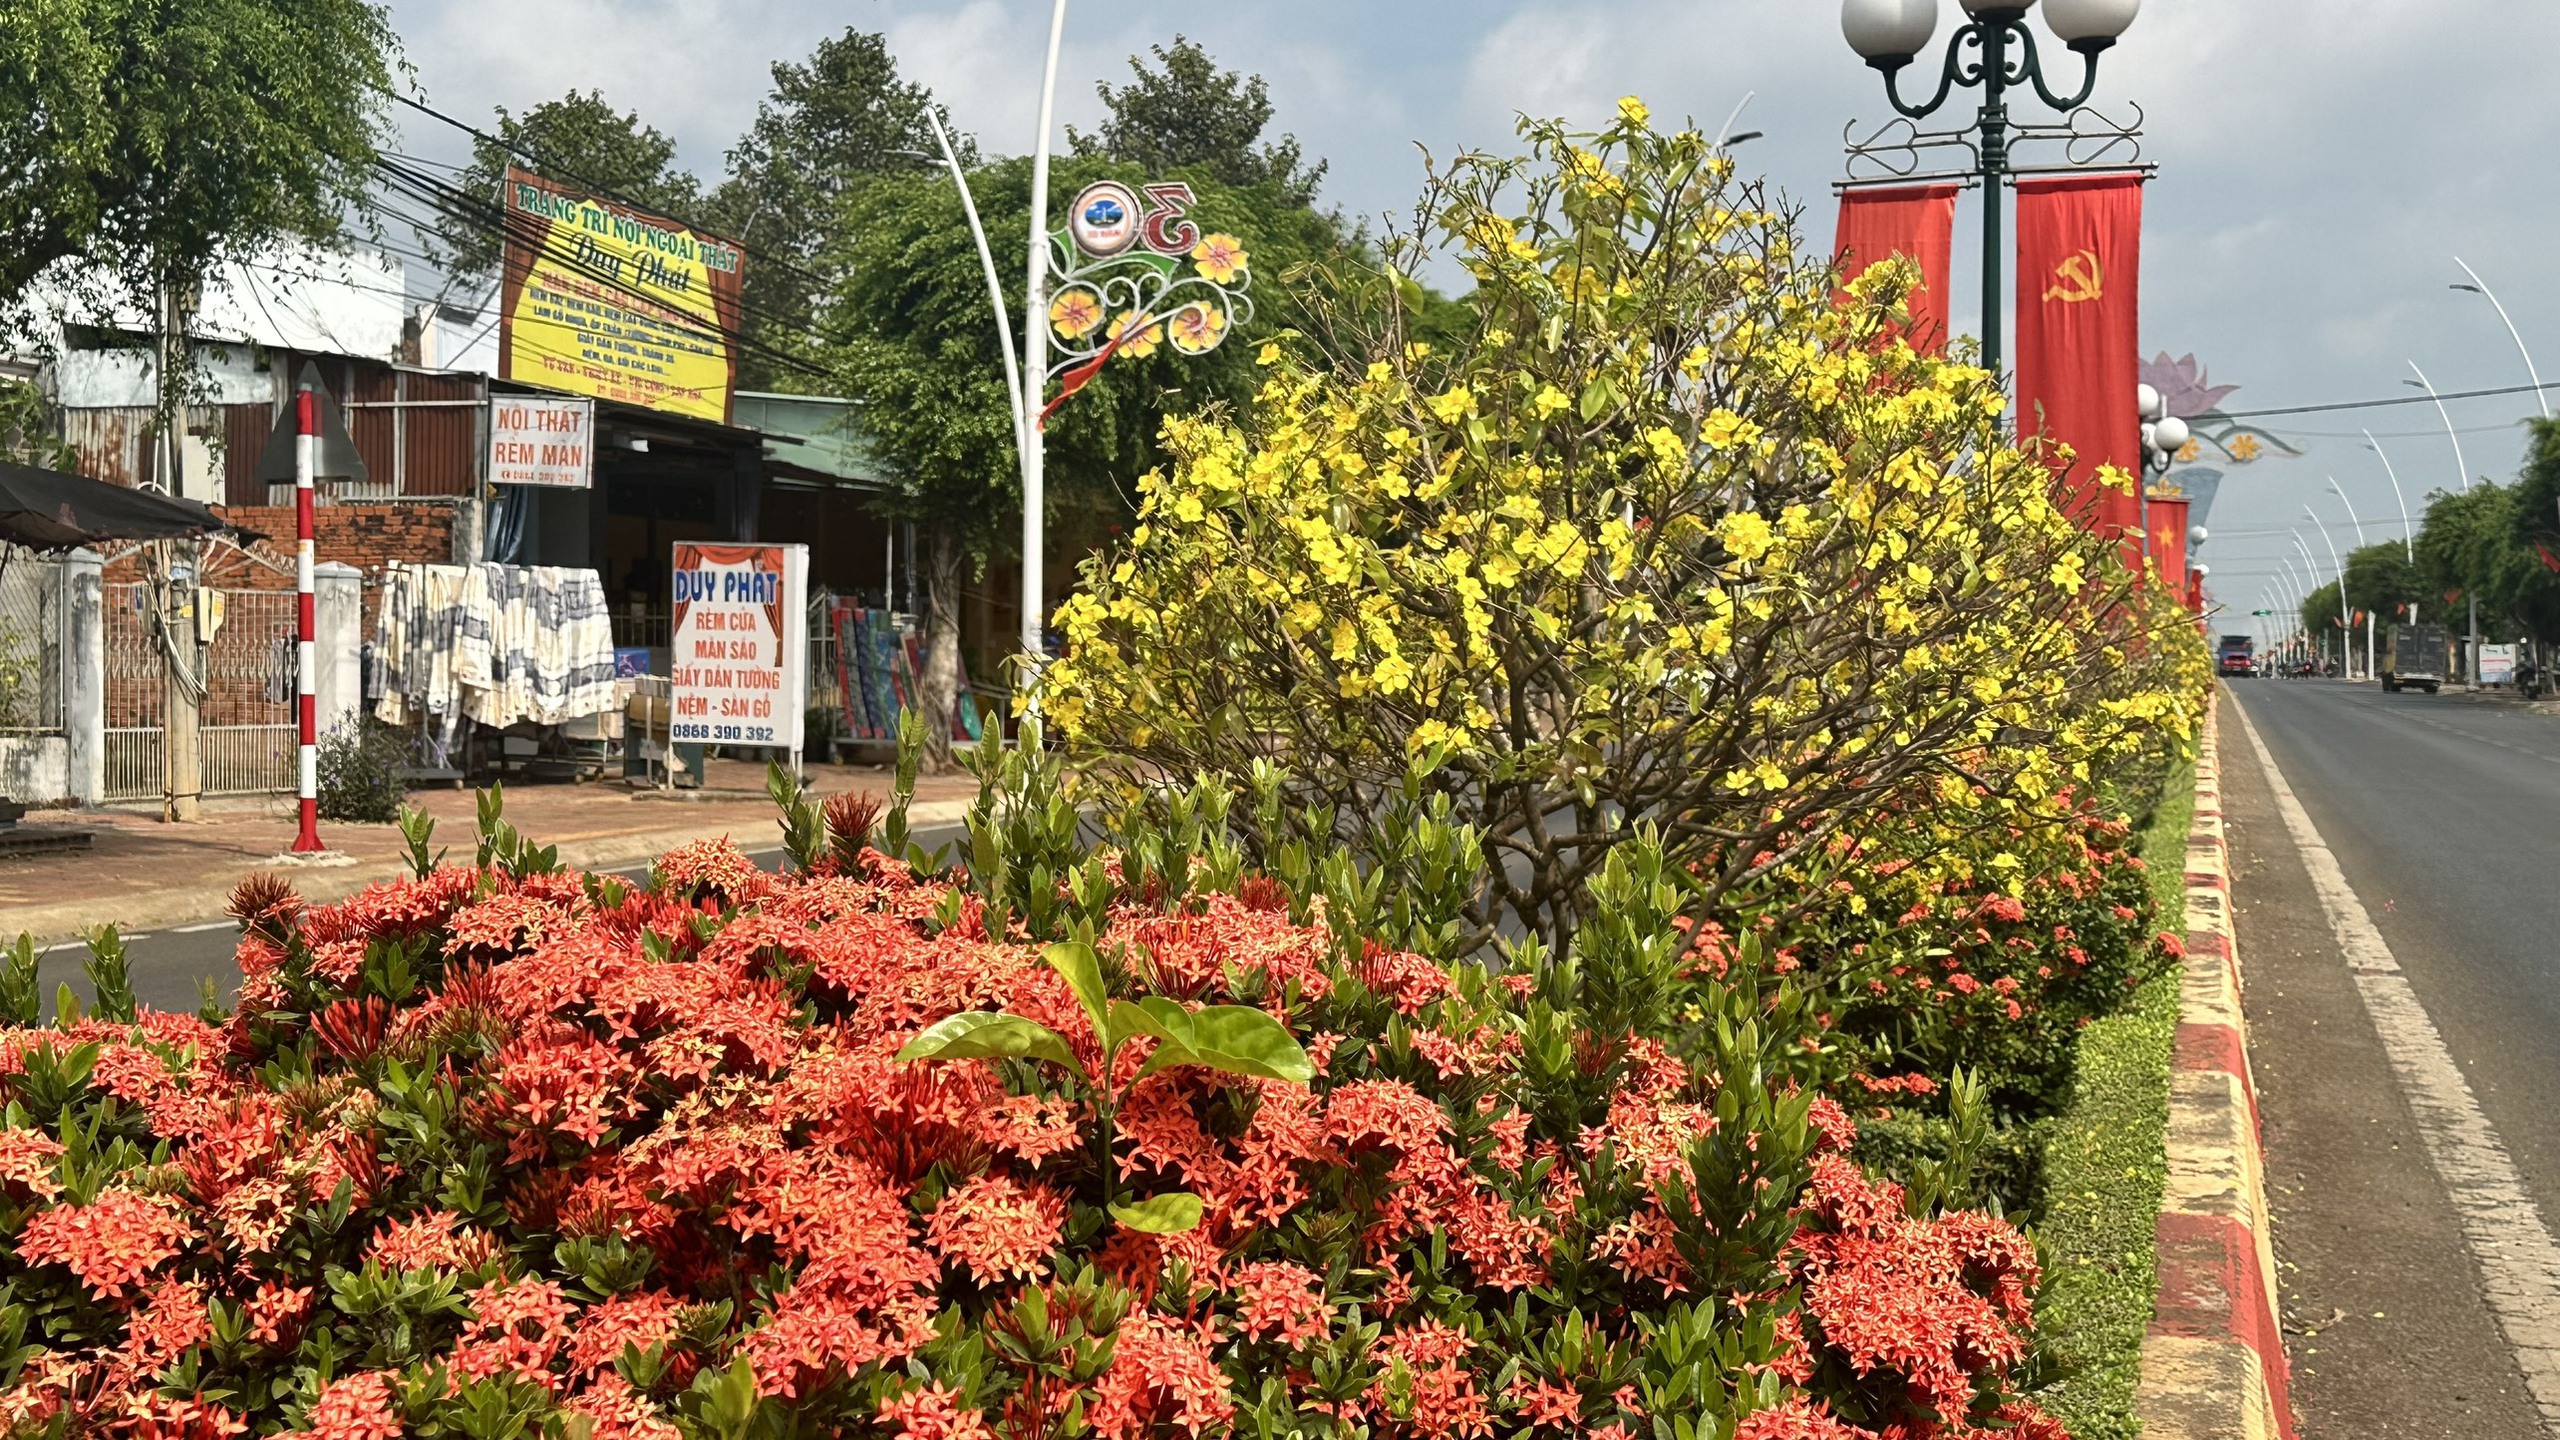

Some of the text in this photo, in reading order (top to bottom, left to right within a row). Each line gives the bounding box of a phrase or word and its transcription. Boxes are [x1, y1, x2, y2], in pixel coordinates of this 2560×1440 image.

[517, 183, 738, 273] TRANG TRÍ NỘI NGOẠI THẤT
[498, 402, 582, 436] NỘI THẤT
[496, 436, 582, 467] RÈM MÀN
[676, 571, 716, 602] DUY
[696, 605, 756, 632] RÈM CỬA
[695, 635, 757, 660] MÀN SÁO
[672, 661, 780, 690] GIẤY DÁN TƯỜNG
[677, 692, 709, 720] NỆM
[720, 692, 750, 717] SÀN
[672, 723, 710, 739] 0868
[713, 725, 741, 740] 390
